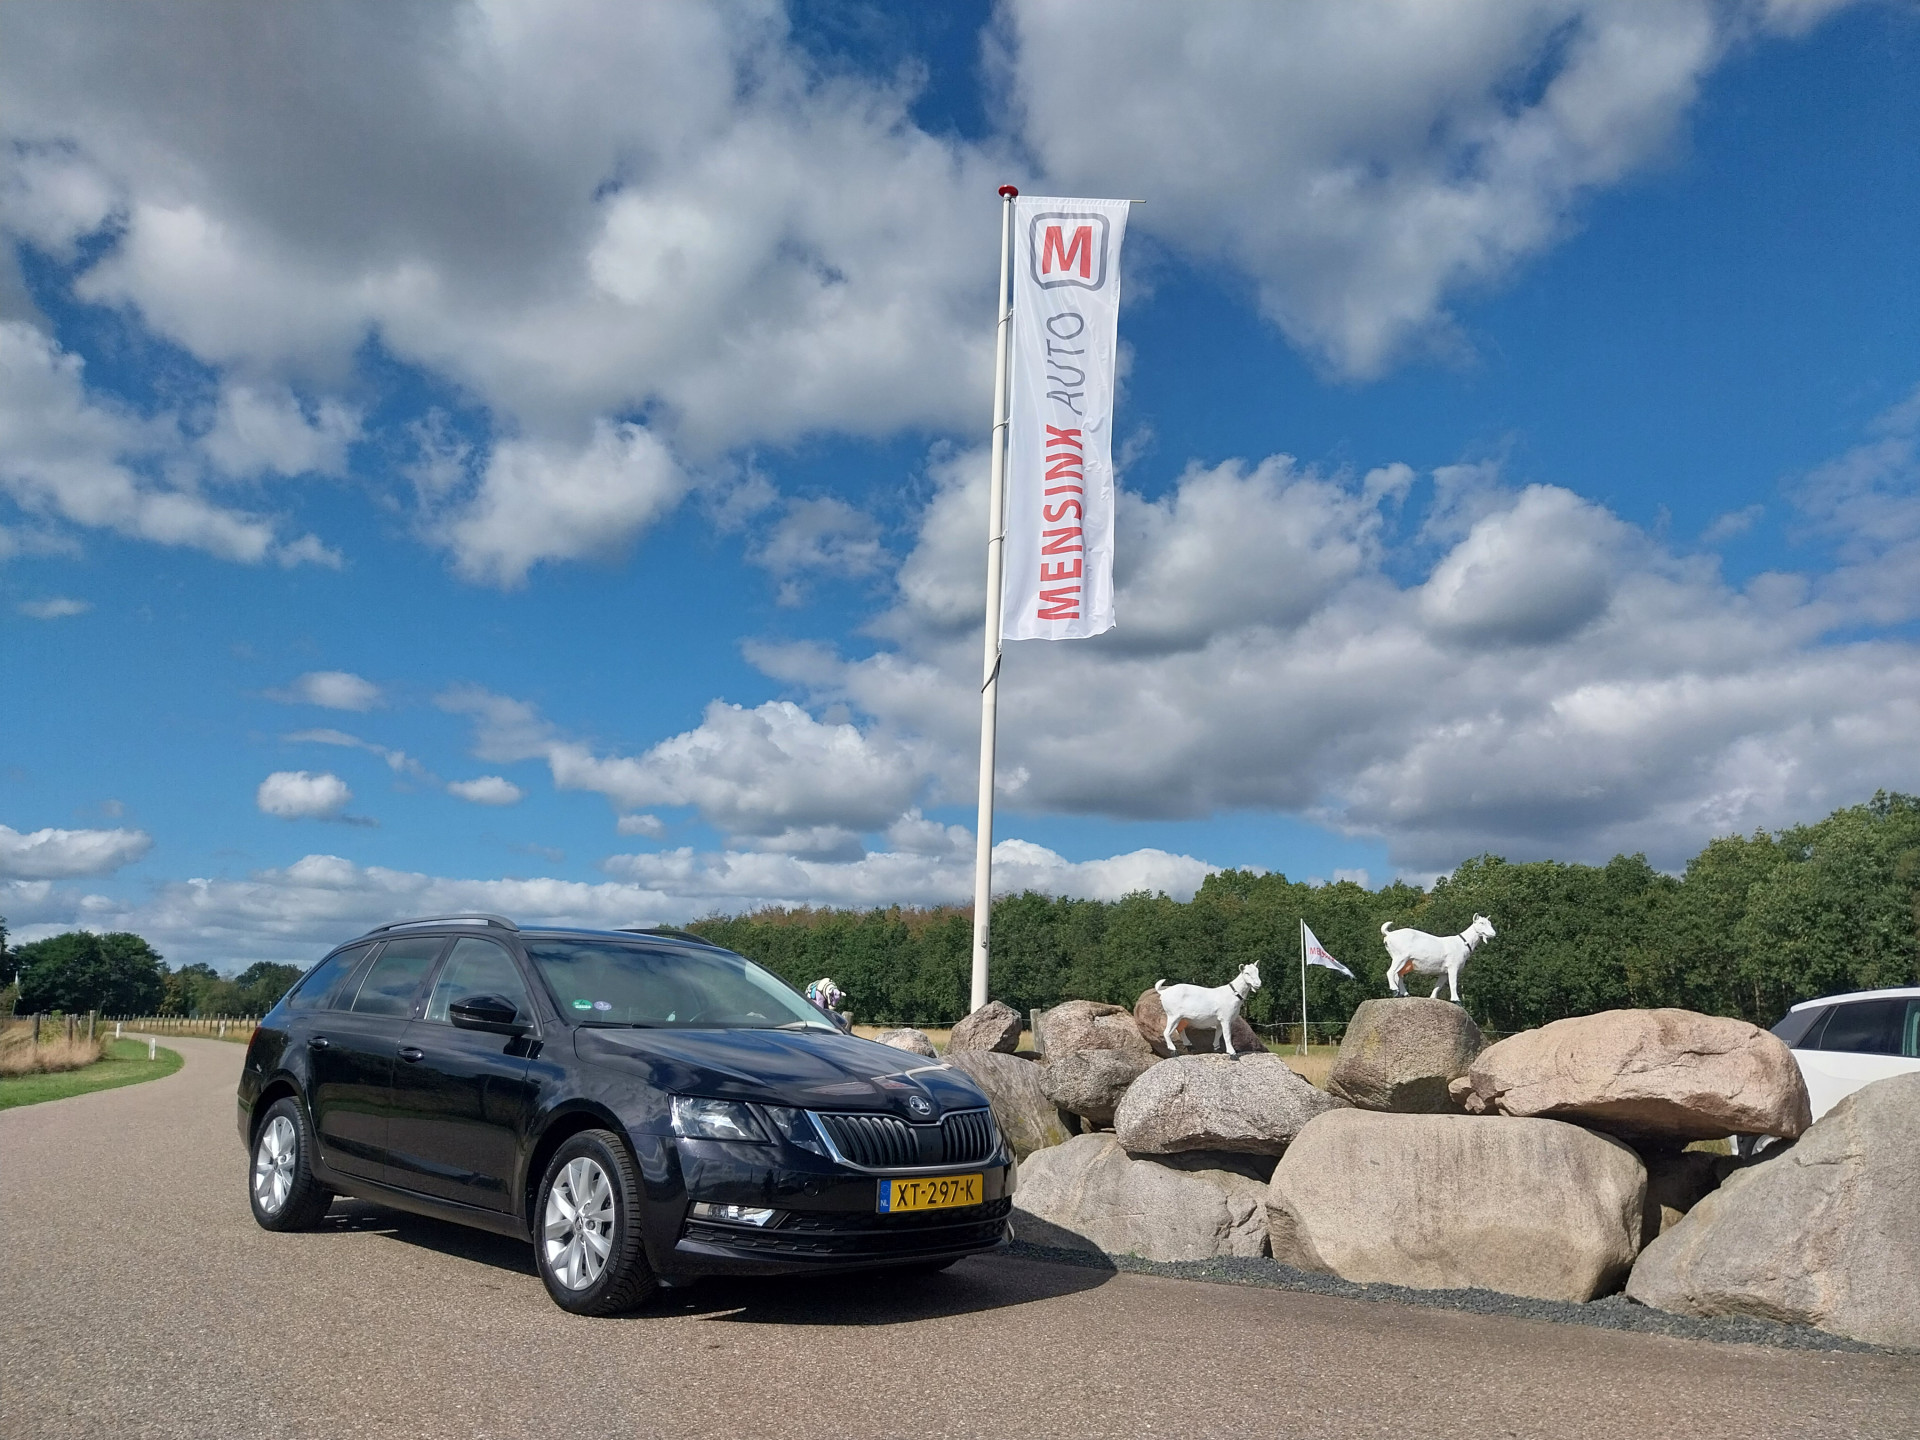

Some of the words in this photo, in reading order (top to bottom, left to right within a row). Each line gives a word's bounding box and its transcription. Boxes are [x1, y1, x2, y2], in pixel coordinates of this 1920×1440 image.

[1042, 226, 1093, 280] M
[1046, 312, 1086, 416] AUTO
[1037, 424, 1084, 621] MENSINK
[880, 1199, 889, 1207] NL
[896, 1179, 975, 1207] XT-297-K
